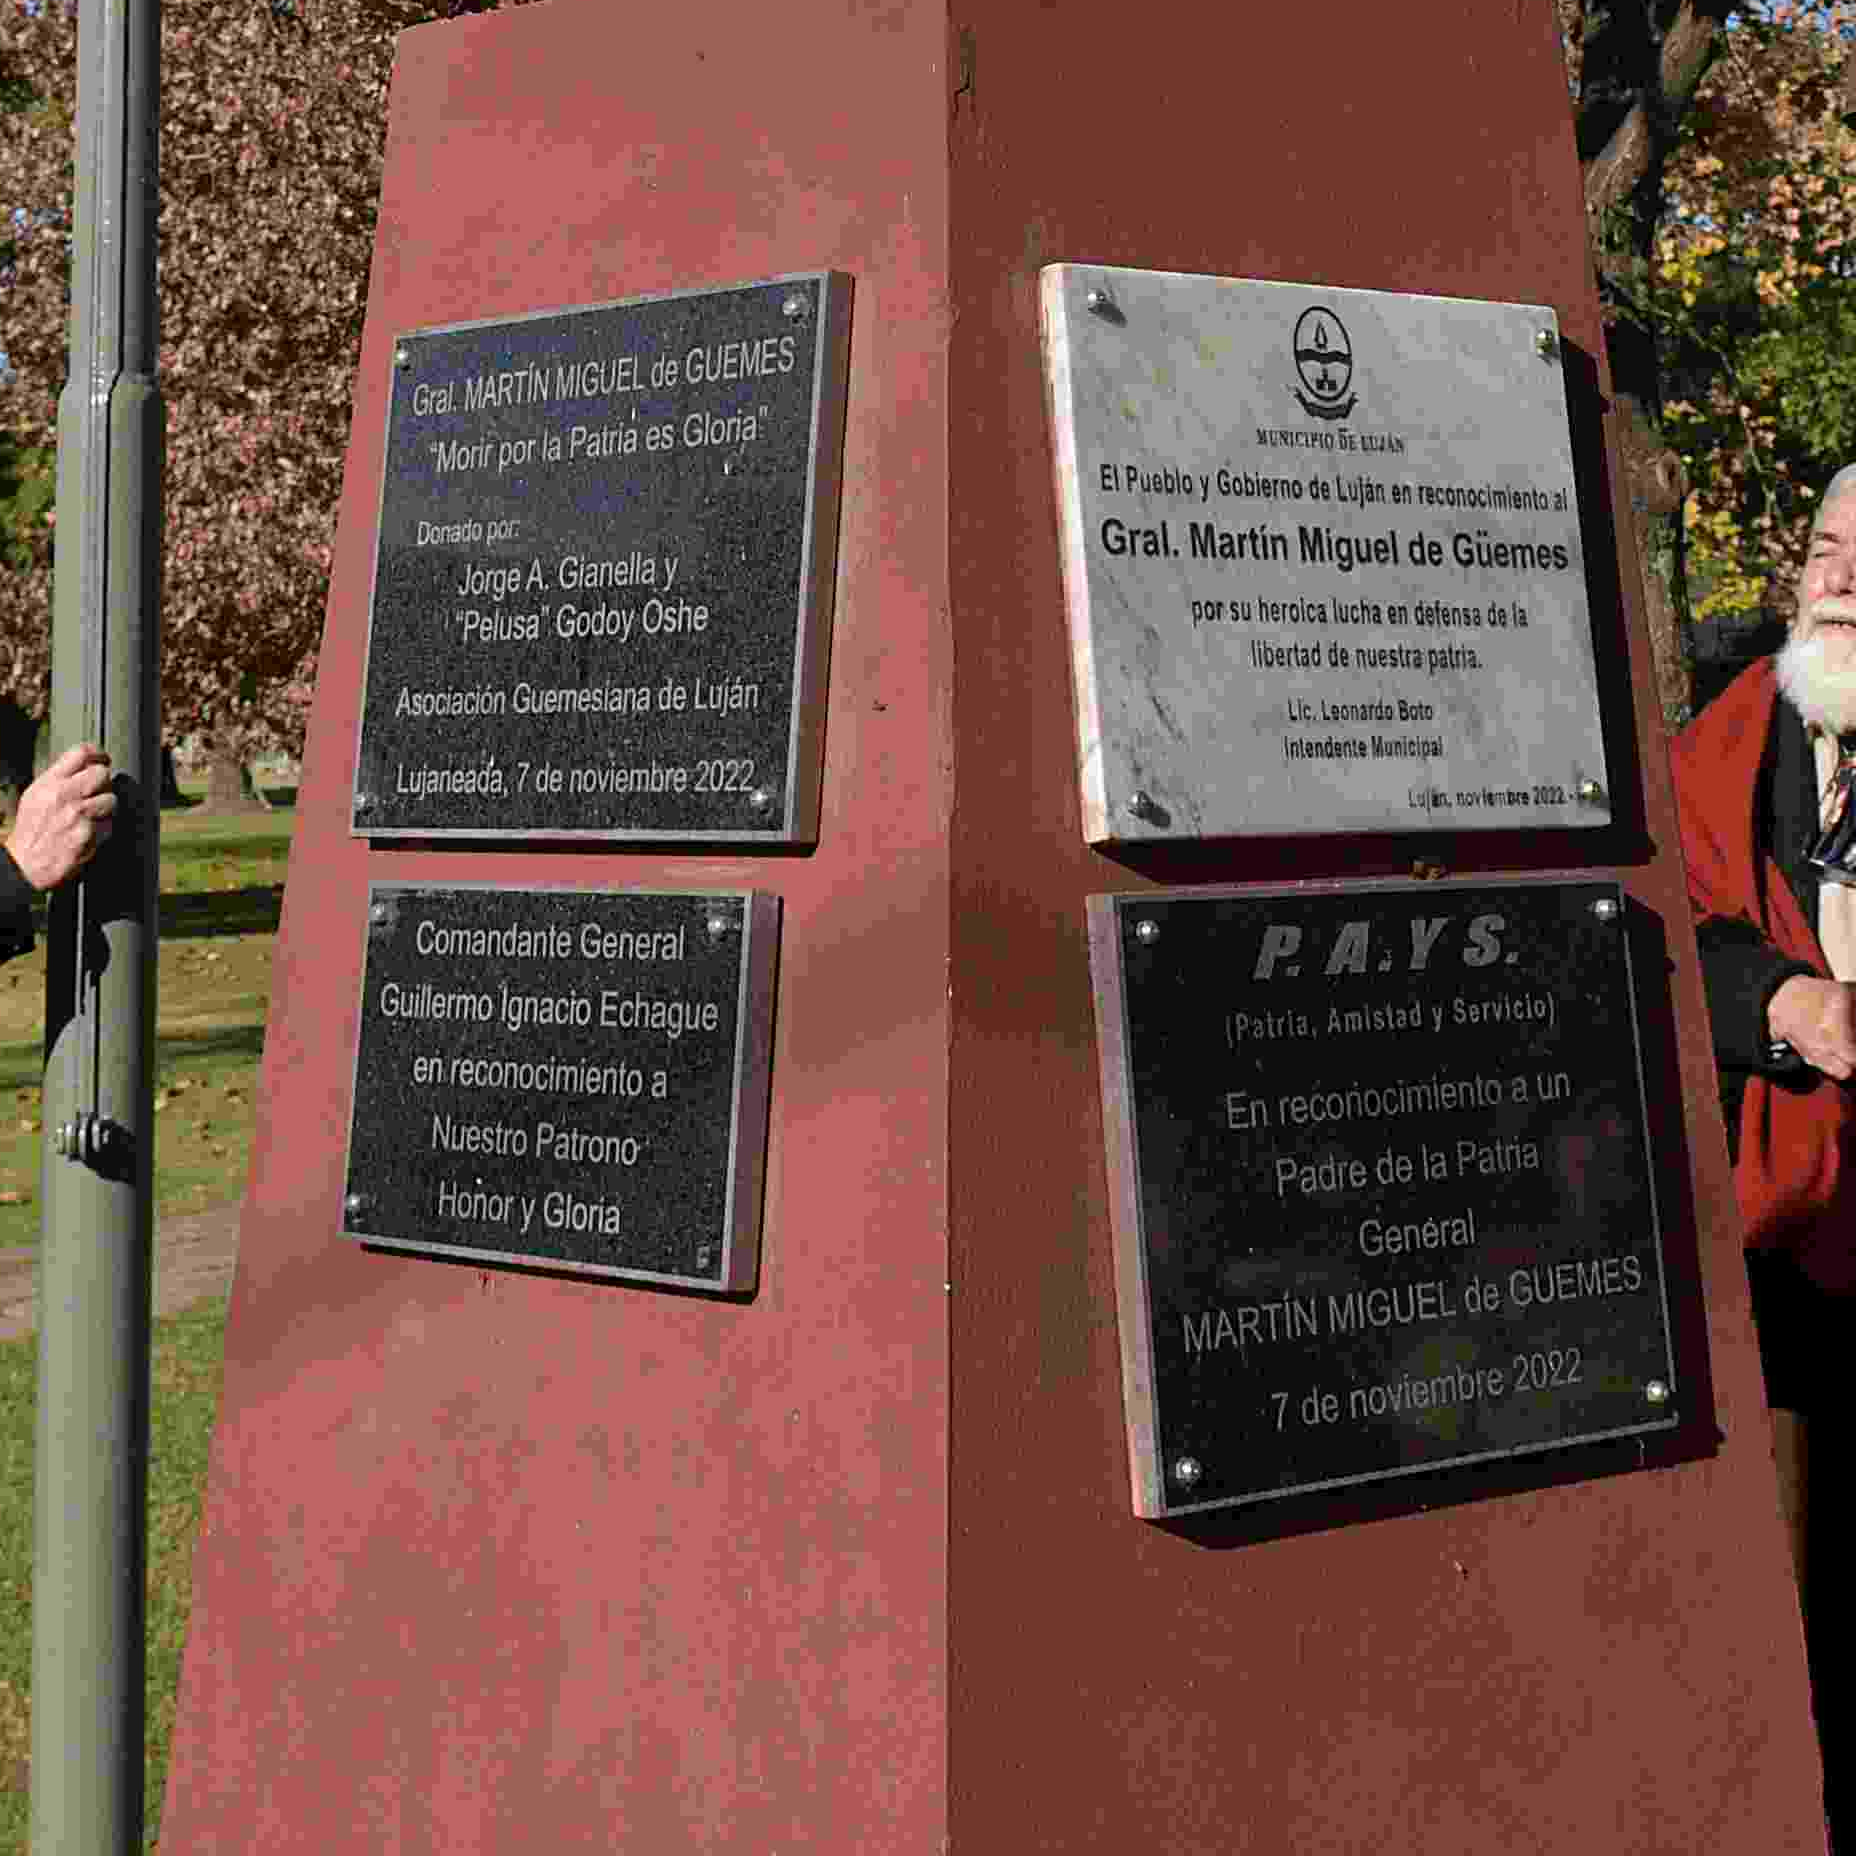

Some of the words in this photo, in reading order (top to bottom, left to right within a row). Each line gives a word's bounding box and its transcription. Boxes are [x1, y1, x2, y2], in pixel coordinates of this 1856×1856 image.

[413, 381, 457, 416] Gral.
[464, 360, 550, 412] MARTÍN
[555, 353, 645, 400] MIGUEL
[650, 352, 680, 387] de
[685, 336, 795, 384] GUEMES
[497, 439, 537, 473] por
[542, 428, 562, 462] la
[569, 422, 638, 459] Patria
[645, 423, 675, 451] es
[1255, 428, 1334, 450] MUNICIPIO
[1338, 428, 1357, 451] DE
[1100, 463, 1120, 493] El
[1125, 464, 1194, 495] Pueblo
[1199, 473, 1210, 504] y
[1215, 468, 1303, 500] Gobierno
[1308, 474, 1331, 501] de
[1335, 473, 1385, 510] Luján
[1392, 482, 1413, 505] en
[1417, 483, 1549, 512] reconocimiento
[1553, 487, 1568, 512] al
[416, 518, 483, 546] Donado
[486, 519, 521, 546] por:
[1100, 517, 1180, 559] Gral.
[1188, 521, 1289, 561] Martín
[1297, 525, 1400, 573] Miguel
[1408, 529, 1444, 567] de
[1452, 528, 1569, 571] Güemes
[457, 562, 522, 601] Jorge
[558, 551, 656, 591] Gianella
[662, 555, 679, 592] y
[556, 601, 635, 644] Godoy
[642, 597, 710, 635] Oshe
[1191, 600, 1223, 630] por
[1229, 600, 1252, 623] su
[1257, 594, 1328, 624] heroica
[1332, 596, 1383, 625] lucha
[1386, 603, 1409, 625] en
[1414, 599, 1481, 628] defensa
[1487, 600, 1508, 628] de
[1511, 600, 1529, 628] la
[1250, 639, 1322, 669] libertad
[1327, 641, 1350, 669] de
[1355, 642, 1423, 670] nuestra
[1427, 642, 1483, 677] patria.
[395, 683, 507, 717] Asociación
[512, 682, 651, 714] Guemesiana
[657, 677, 688, 711] de
[694, 675, 759, 718] Luján
[1287, 695, 1317, 722] Lic.
[1321, 696, 1394, 721] Leonardo
[1397, 698, 1434, 722] Boto
[1283, 735, 1368, 760] Intendente
[1370, 735, 1443, 761] Municipal
[396, 761, 509, 801] Lujaneada,
[517, 761, 531, 793] 7
[535, 760, 563, 793] de
[568, 760, 688, 793] noviembre
[694, 759, 755, 793] 2022
[1455, 786, 1529, 808] noviembre
[415, 919, 572, 959] Comandante
[580, 921, 686, 961] General
[380, 982, 493, 1022] Guillermo
[500, 985, 592, 1032] Ignacio
[599, 991, 719, 1039] Echague
[1224, 1008, 1320, 1049] (Patria,
[1327, 999, 1423, 1034] Amistad
[1431, 1007, 1443, 1033] y
[1453, 991, 1555, 1031] Servicio)
[412, 1055, 444, 1084] en
[449, 1055, 644, 1096] reconocimiento
[650, 1070, 668, 1099] a
[1225, 1090, 1273, 1129] En
[1279, 1072, 1503, 1126] reconocimiento
[1511, 1075, 1529, 1104] a
[1536, 1071, 1572, 1102] un
[431, 1112, 528, 1156] Nuestro
[535, 1120, 639, 1166] Patrono
[1275, 1152, 1368, 1197] Padre
[1376, 1144, 1414, 1185] de
[1421, 1143, 1449, 1182] la
[1456, 1135, 1540, 1177] Patria
[437, 1179, 515, 1224] Honor
[519, 1195, 537, 1234] y
[543, 1191, 621, 1234] Gloria
[1359, 1207, 1476, 1256] General
[1182, 1289, 1318, 1353] MARTÍN
[1327, 1280, 1457, 1334] MIGUEL
[1463, 1274, 1500, 1313] de
[1508, 1255, 1642, 1306] GUEMES
[1270, 1391, 1290, 1432] 7
[1301, 1383, 1340, 1425] de
[1349, 1362, 1505, 1419] noviembre
[1511, 1346, 1584, 1392] 2022
